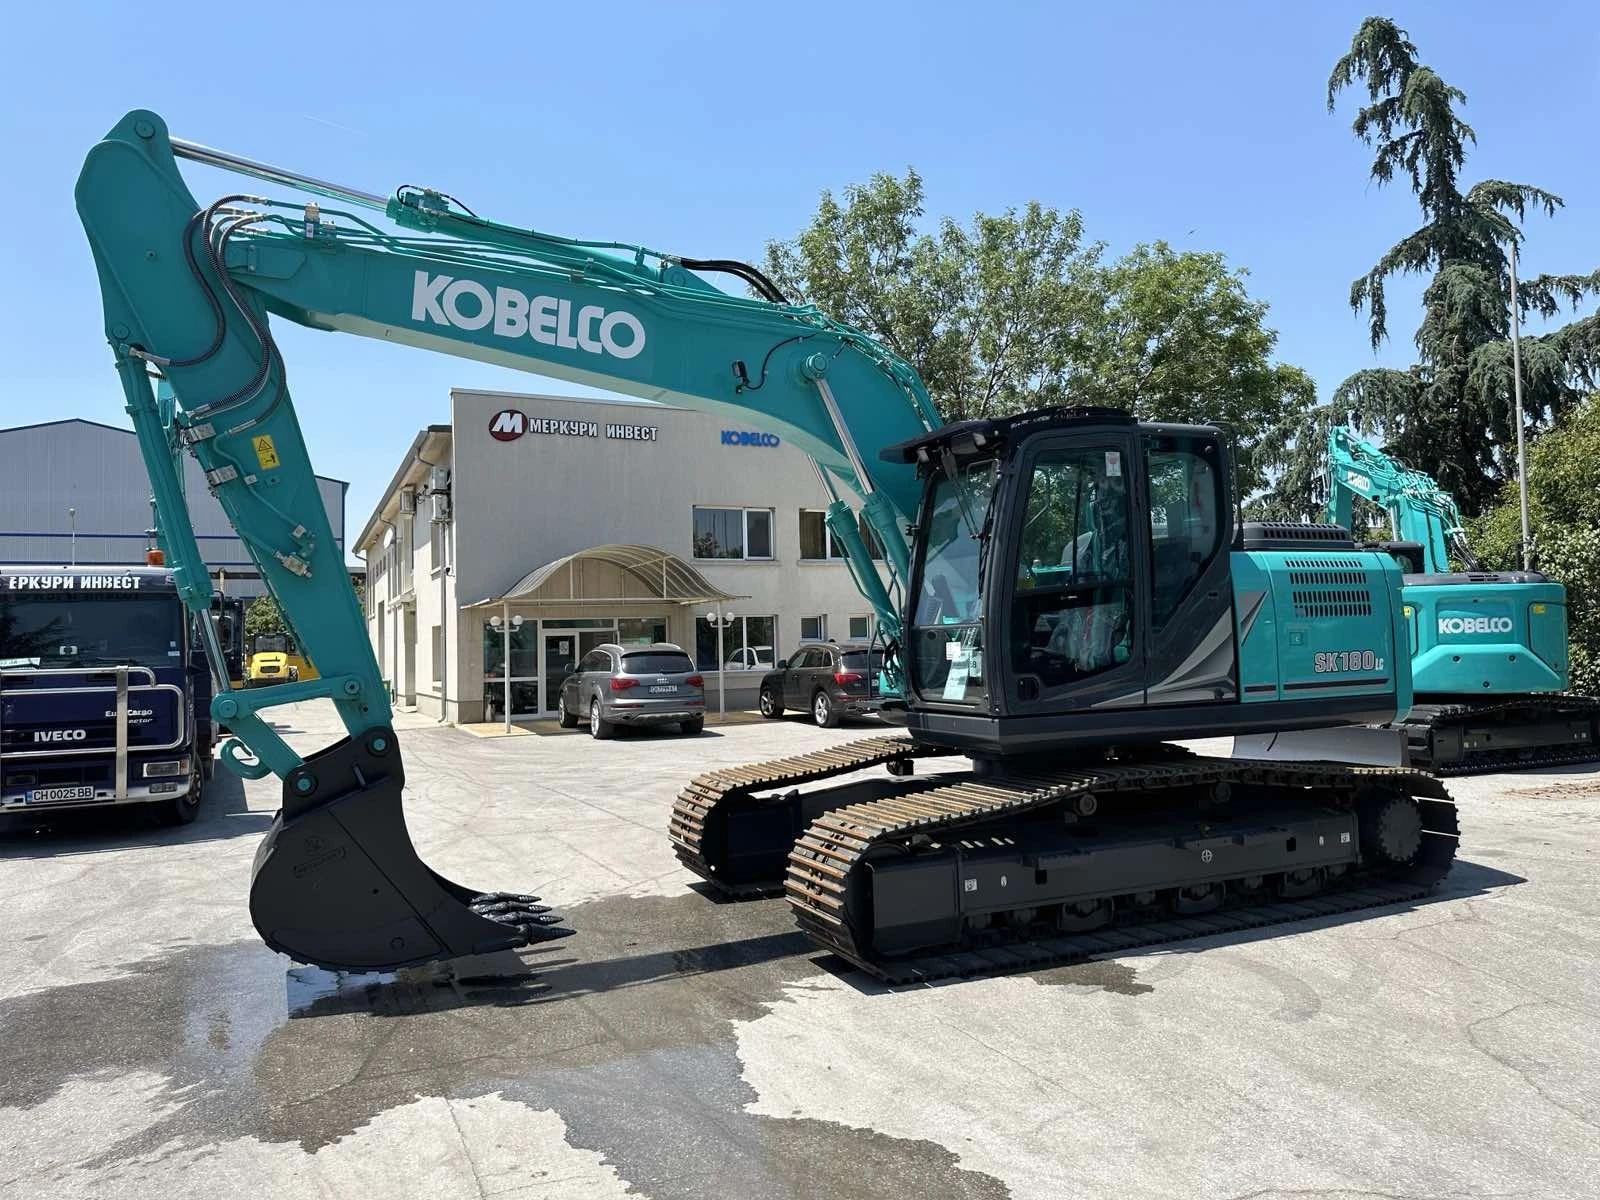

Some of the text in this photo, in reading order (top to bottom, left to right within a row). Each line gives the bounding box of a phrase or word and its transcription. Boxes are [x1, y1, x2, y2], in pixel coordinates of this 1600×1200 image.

[411, 270, 646, 359] KOBELCO
[529, 418, 599, 437] МЕРКУРИ
[606, 424, 658, 441] ИНВЕСТ
[721, 430, 780, 448] KOBELCO
[80, 576, 141, 589] ИНВЕСТ
[1438, 617, 1513, 634] KOBELCO
[34, 729, 87, 742] IVECO
[50, 788, 76, 799] 0025
[77, 787, 92, 798] BB
